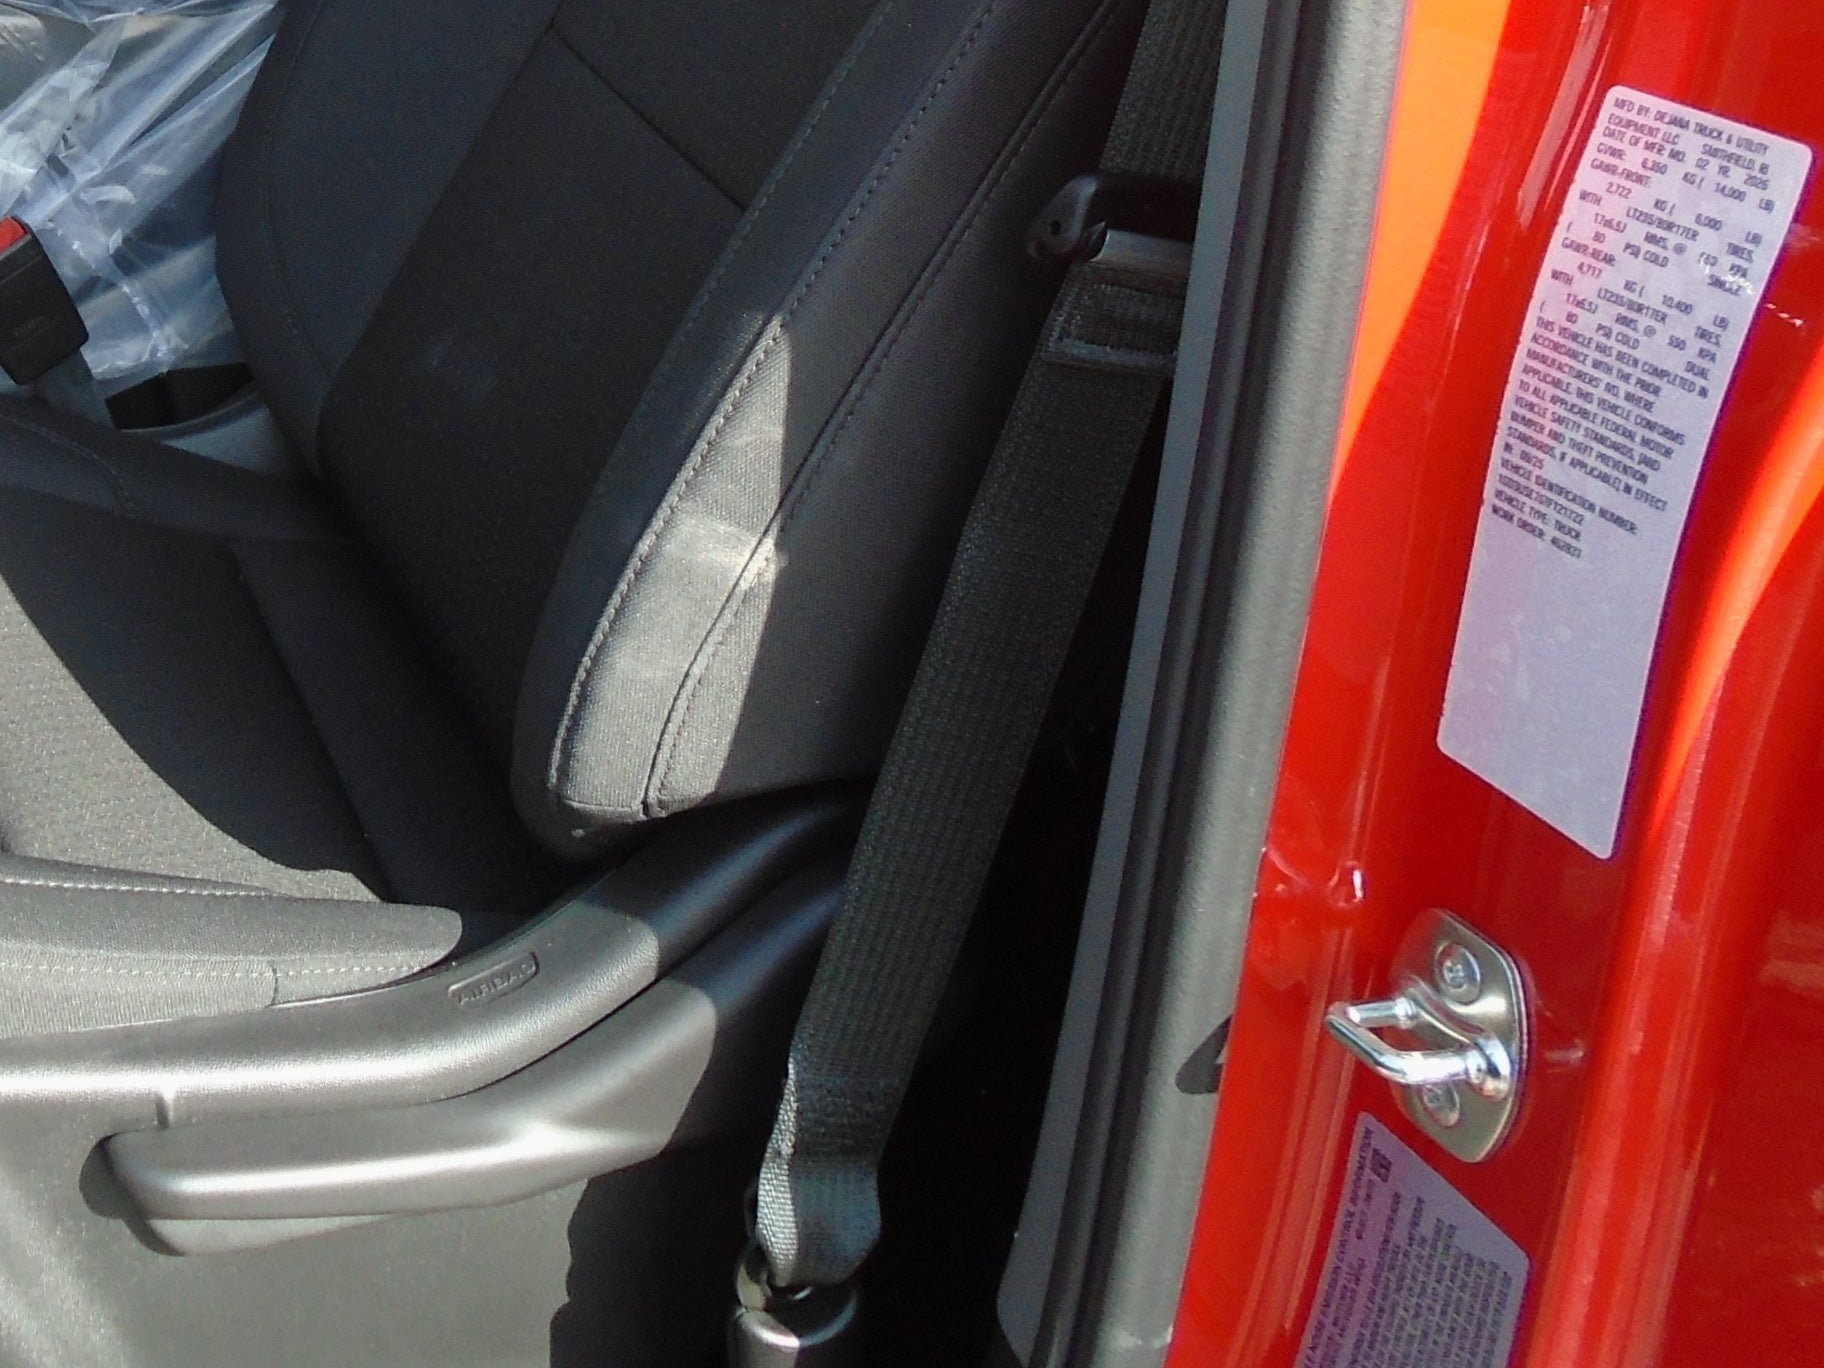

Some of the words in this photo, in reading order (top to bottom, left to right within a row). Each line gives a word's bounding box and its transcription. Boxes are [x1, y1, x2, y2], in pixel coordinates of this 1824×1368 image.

[1603, 127, 1625, 142] DATE
[1628, 136, 1640, 147] OF
[1695, 158, 1709, 169] 02
[1608, 113, 1659, 138] EQUIPMENT
[1662, 131, 1680, 145] LLC
[1653, 111, 1690, 130] DEJANA
[1693, 123, 1723, 141] TRUCK
[1736, 137, 1768, 155] UTILITY
[1579, 190, 1601, 205] WITH
[1682, 171, 1695, 184] KG
[1714, 182, 1746, 202] 14,000
[1653, 199, 1667, 211] KG
[1694, 213, 1722, 231] 6,000
[1550, 269, 1573, 285] WITH
[1643, 250, 1669, 268] COLD
[1623, 280, 1637, 293] KG
[1530, 333, 1588, 365] ACCORDANCE
[1591, 359, 1613, 375] WITH
[1615, 369, 1632, 383] THE
[1634, 377, 1661, 396] PRIOR
[1535, 317, 1555, 332] THIS
[1557, 326, 1592, 348] VEHICLE
[1594, 342, 1613, 357] HAS
[1615, 351, 1638, 368] BEEN
[1640, 362, 1696, 393] COMPLETED
[1698, 386, 1709, 398] IN
[1614, 332, 1639, 349] COLD
[1684, 361, 1710, 380] DUAL
[1667, 335, 1686, 350] 550
[1697, 347, 1717, 362] KPA
[1514, 396, 1548, 418] VEHICLE
[1550, 412, 1580, 433] SAFETY
[1518, 380, 1530, 392] TO
[1532, 386, 1546, 399] ALL
[1549, 394, 1597, 423] APPLICABLE
[1600, 417, 1637, 441] FEDERAL
[1639, 436, 1673, 458] MOTOR
[1575, 388, 1594, 404] THIS
[1595, 397, 1631, 420] VEHICLE
[1633, 414, 1686, 445] CONFORMS
[1623, 391, 1654, 412] WHERE
[1510, 411, 1545, 434] BUMPER
[1547, 429, 1565, 444] AND
[1567, 438, 1593, 457] THEFT
[1594, 451, 1648, 484] PREVENTION
[1499, 458, 1532, 480] VEHICLE
[1534, 475, 1596, 513] IDENTIFICATION
[1559, 452, 1566, 462] IF
[1623, 483, 1633, 495] IN
[1634, 489, 1667, 512] EFFECT
[1491, 504, 1513, 522] WORK
[1494, 489, 1526, 513] VEHICLE
[1553, 520, 1581, 540] TRUCK
